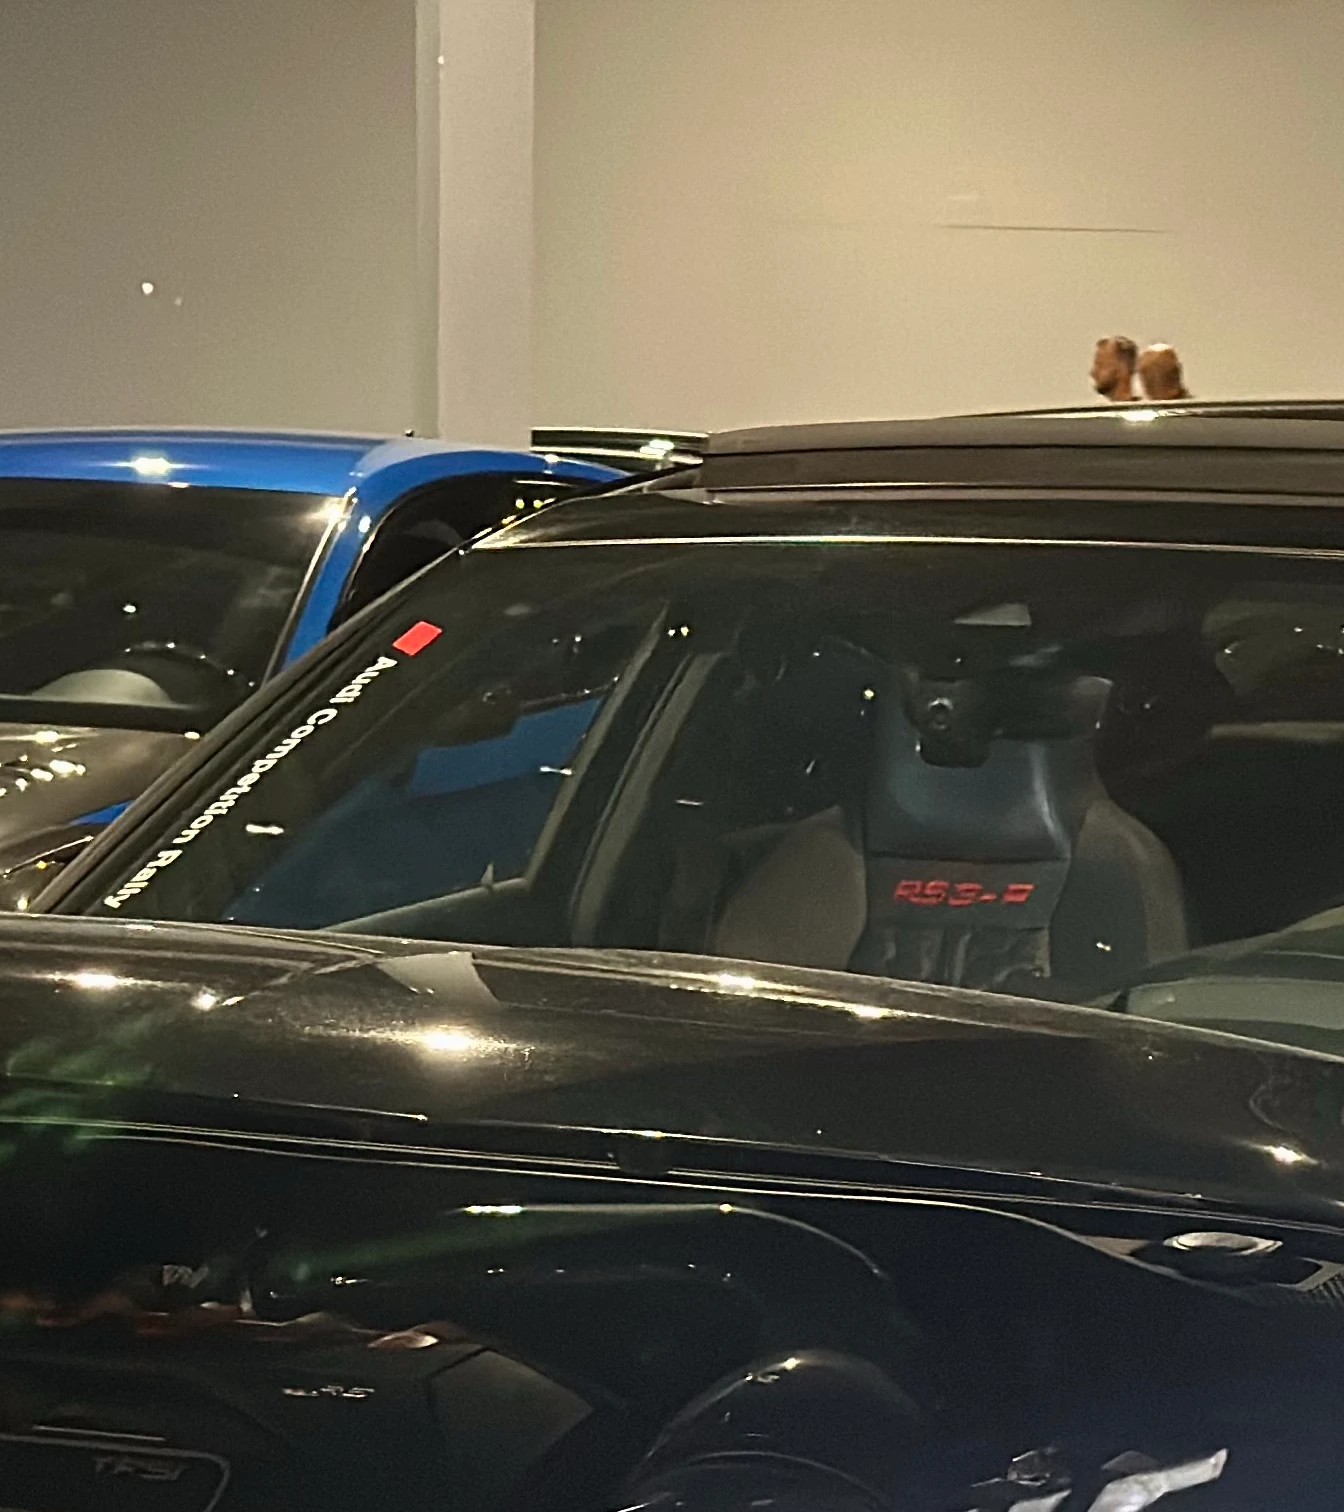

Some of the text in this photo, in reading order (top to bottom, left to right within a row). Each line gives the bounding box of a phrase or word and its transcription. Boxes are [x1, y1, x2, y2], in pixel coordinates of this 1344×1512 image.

[103, 655, 398, 910] Audi Competition Rally
